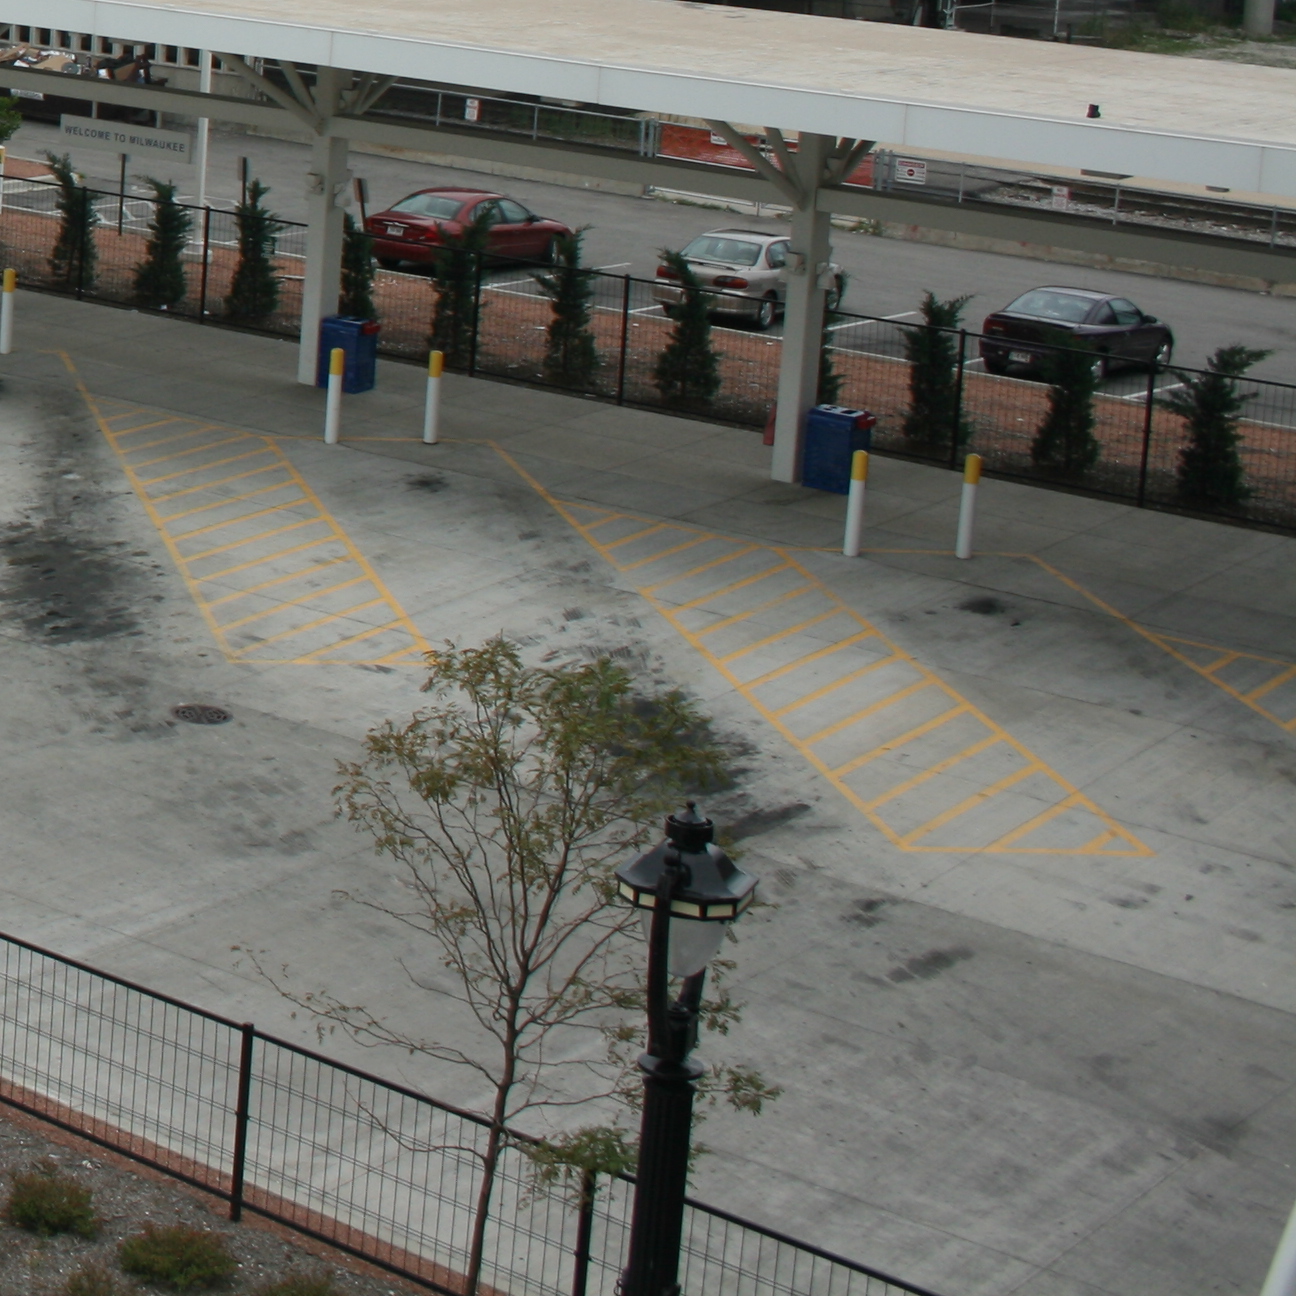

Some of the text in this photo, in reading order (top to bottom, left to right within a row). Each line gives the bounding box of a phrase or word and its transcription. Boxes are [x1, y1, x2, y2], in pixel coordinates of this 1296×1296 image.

[64, 125, 185, 152] WELCOME TO MILWAUKEE
